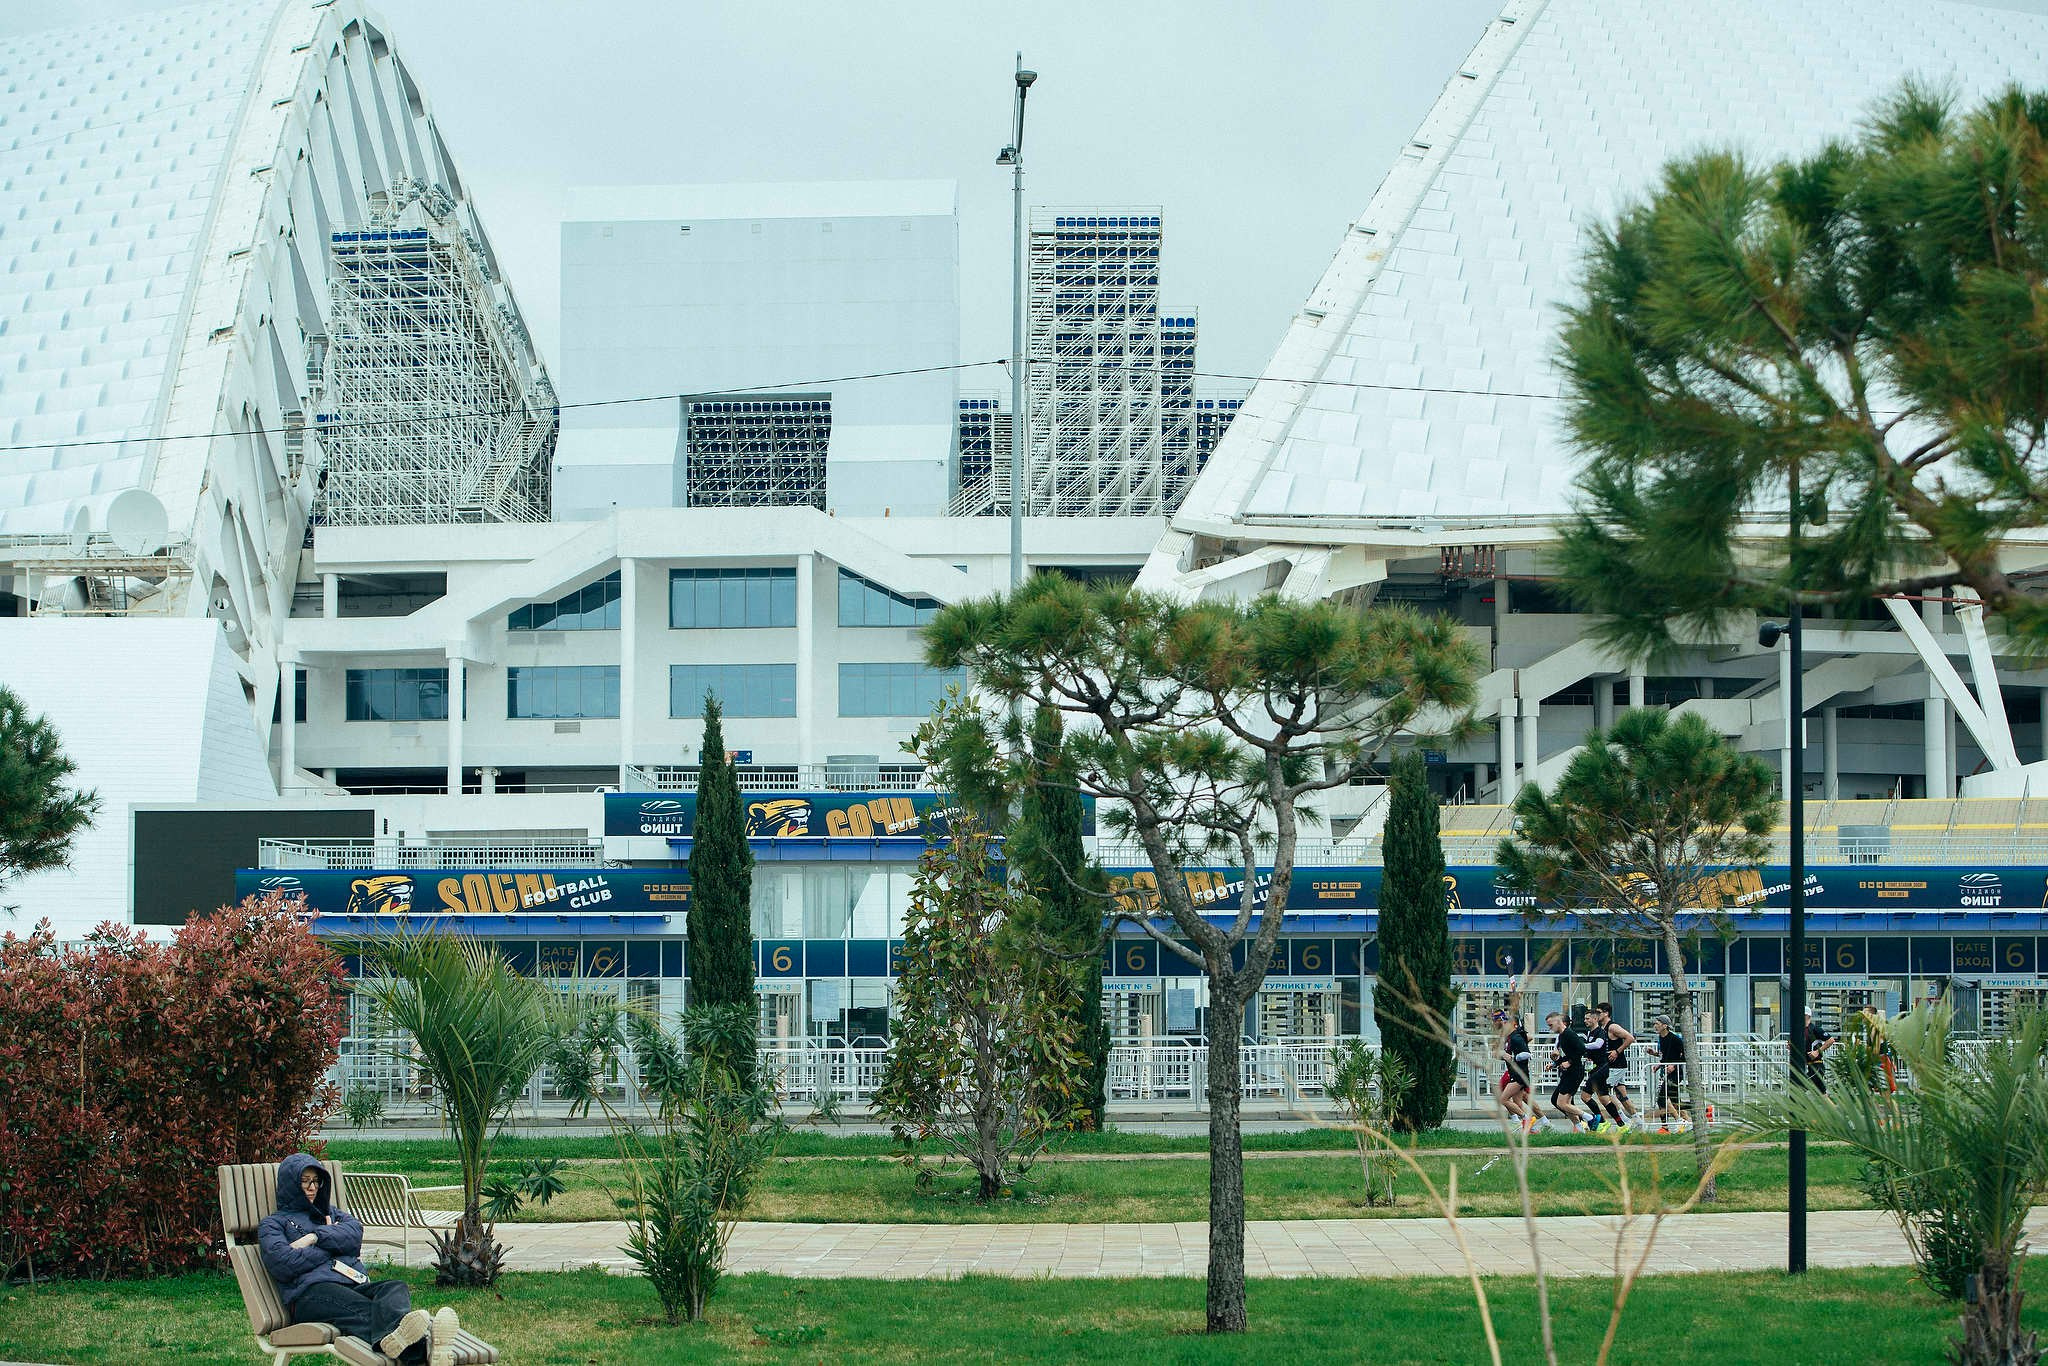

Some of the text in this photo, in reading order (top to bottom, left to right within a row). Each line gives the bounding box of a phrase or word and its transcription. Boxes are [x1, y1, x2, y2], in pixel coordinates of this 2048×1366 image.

[826, 798, 919, 836] СОЧИ
[640, 823, 683, 834] ФИШТ
[437, 873, 560, 912] SOCHI
[523, 875, 608, 906] FOOTBALL
[570, 889, 612, 909] CLUB
[1107, 871, 1230, 911] SOHI
[1193, 873, 1273, 904] FOOTBL
[1676, 870, 1767, 908] СОЧИ
[1737, 873, 1817, 903] ФУТБОЛЬЙ
[1804, 885, 1825, 897] ЛУБ
[1494, 896, 1537, 906] ФИШТ
[1960, 896, 2002, 906] ФИШТ
[541, 946, 575, 957] GATE
[1126, 946, 1146, 971] 6
[1303, 945, 1322, 970] 6
[1454, 944, 1477, 954] ATE
[1785, 943, 1817, 953] GTE
[1837, 943, 1856, 968] 6
[1955, 943, 1987, 952] GATE
[2006, 943, 2025, 968] 6
[594, 946, 614, 972] 6
[772, 946, 793, 972] 6
[1617, 958, 1653, 969] ВХОД
[1786, 958, 1821, 968] ВОД
[1956, 957, 1991, 967] ВХОД
[786, 984, 792, 992] 3
